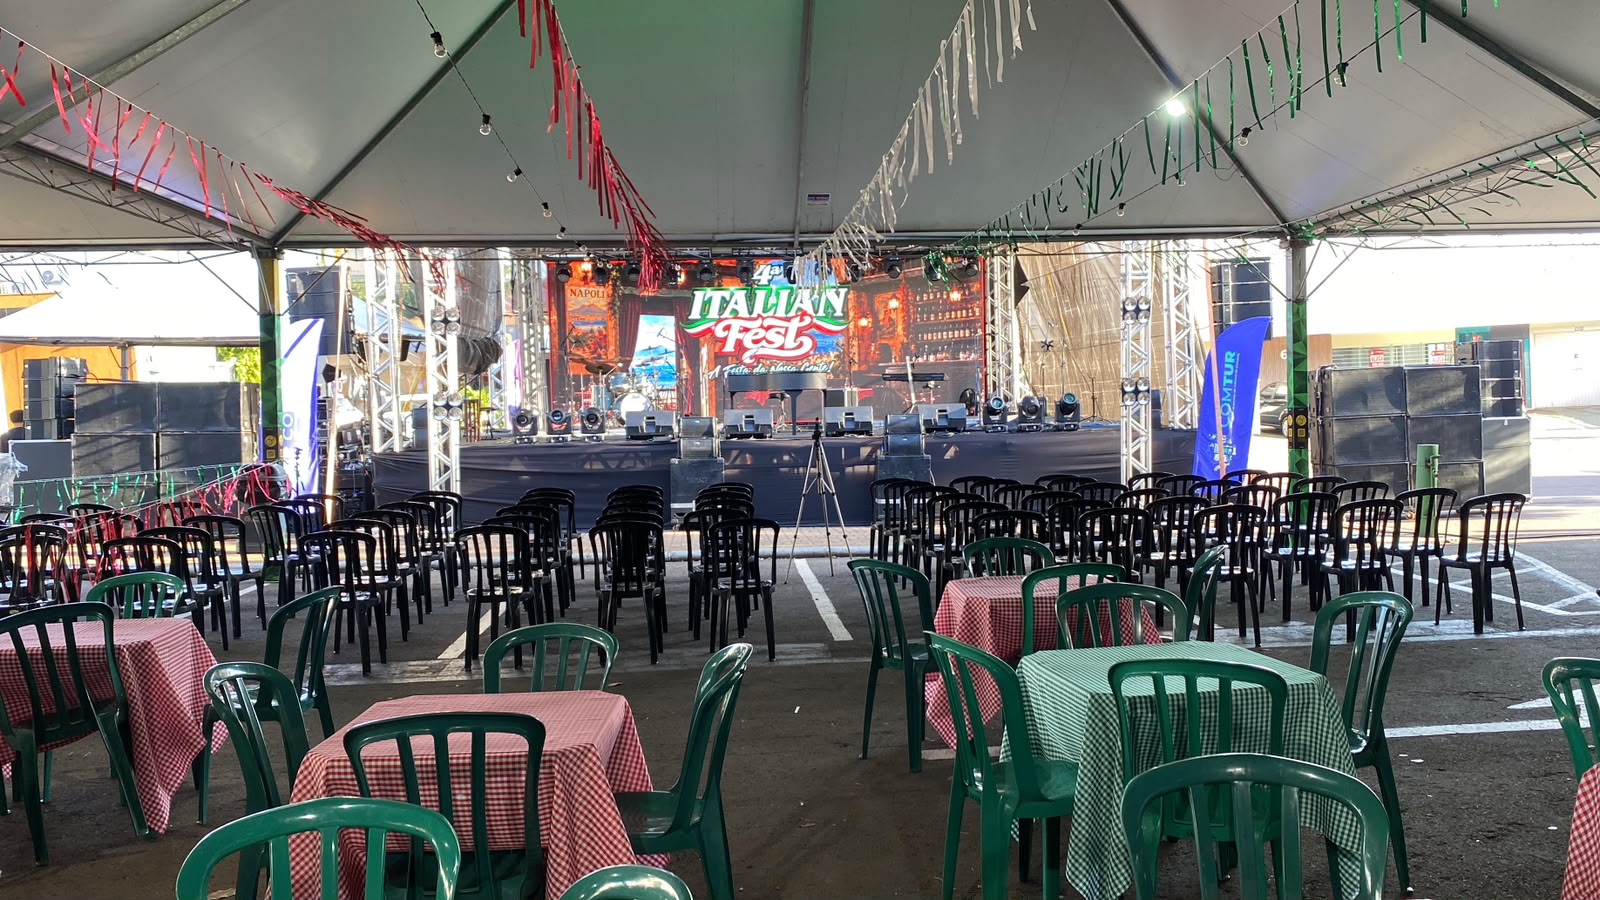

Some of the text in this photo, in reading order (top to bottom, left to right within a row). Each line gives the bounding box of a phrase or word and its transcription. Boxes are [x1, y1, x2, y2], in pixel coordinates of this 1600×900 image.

[569, 288, 605, 299] NAPOLI
[688, 288, 849, 319] ITALIAN
[714, 316, 814, 363] Fest
[1220, 350, 1236, 428] COMTUR
